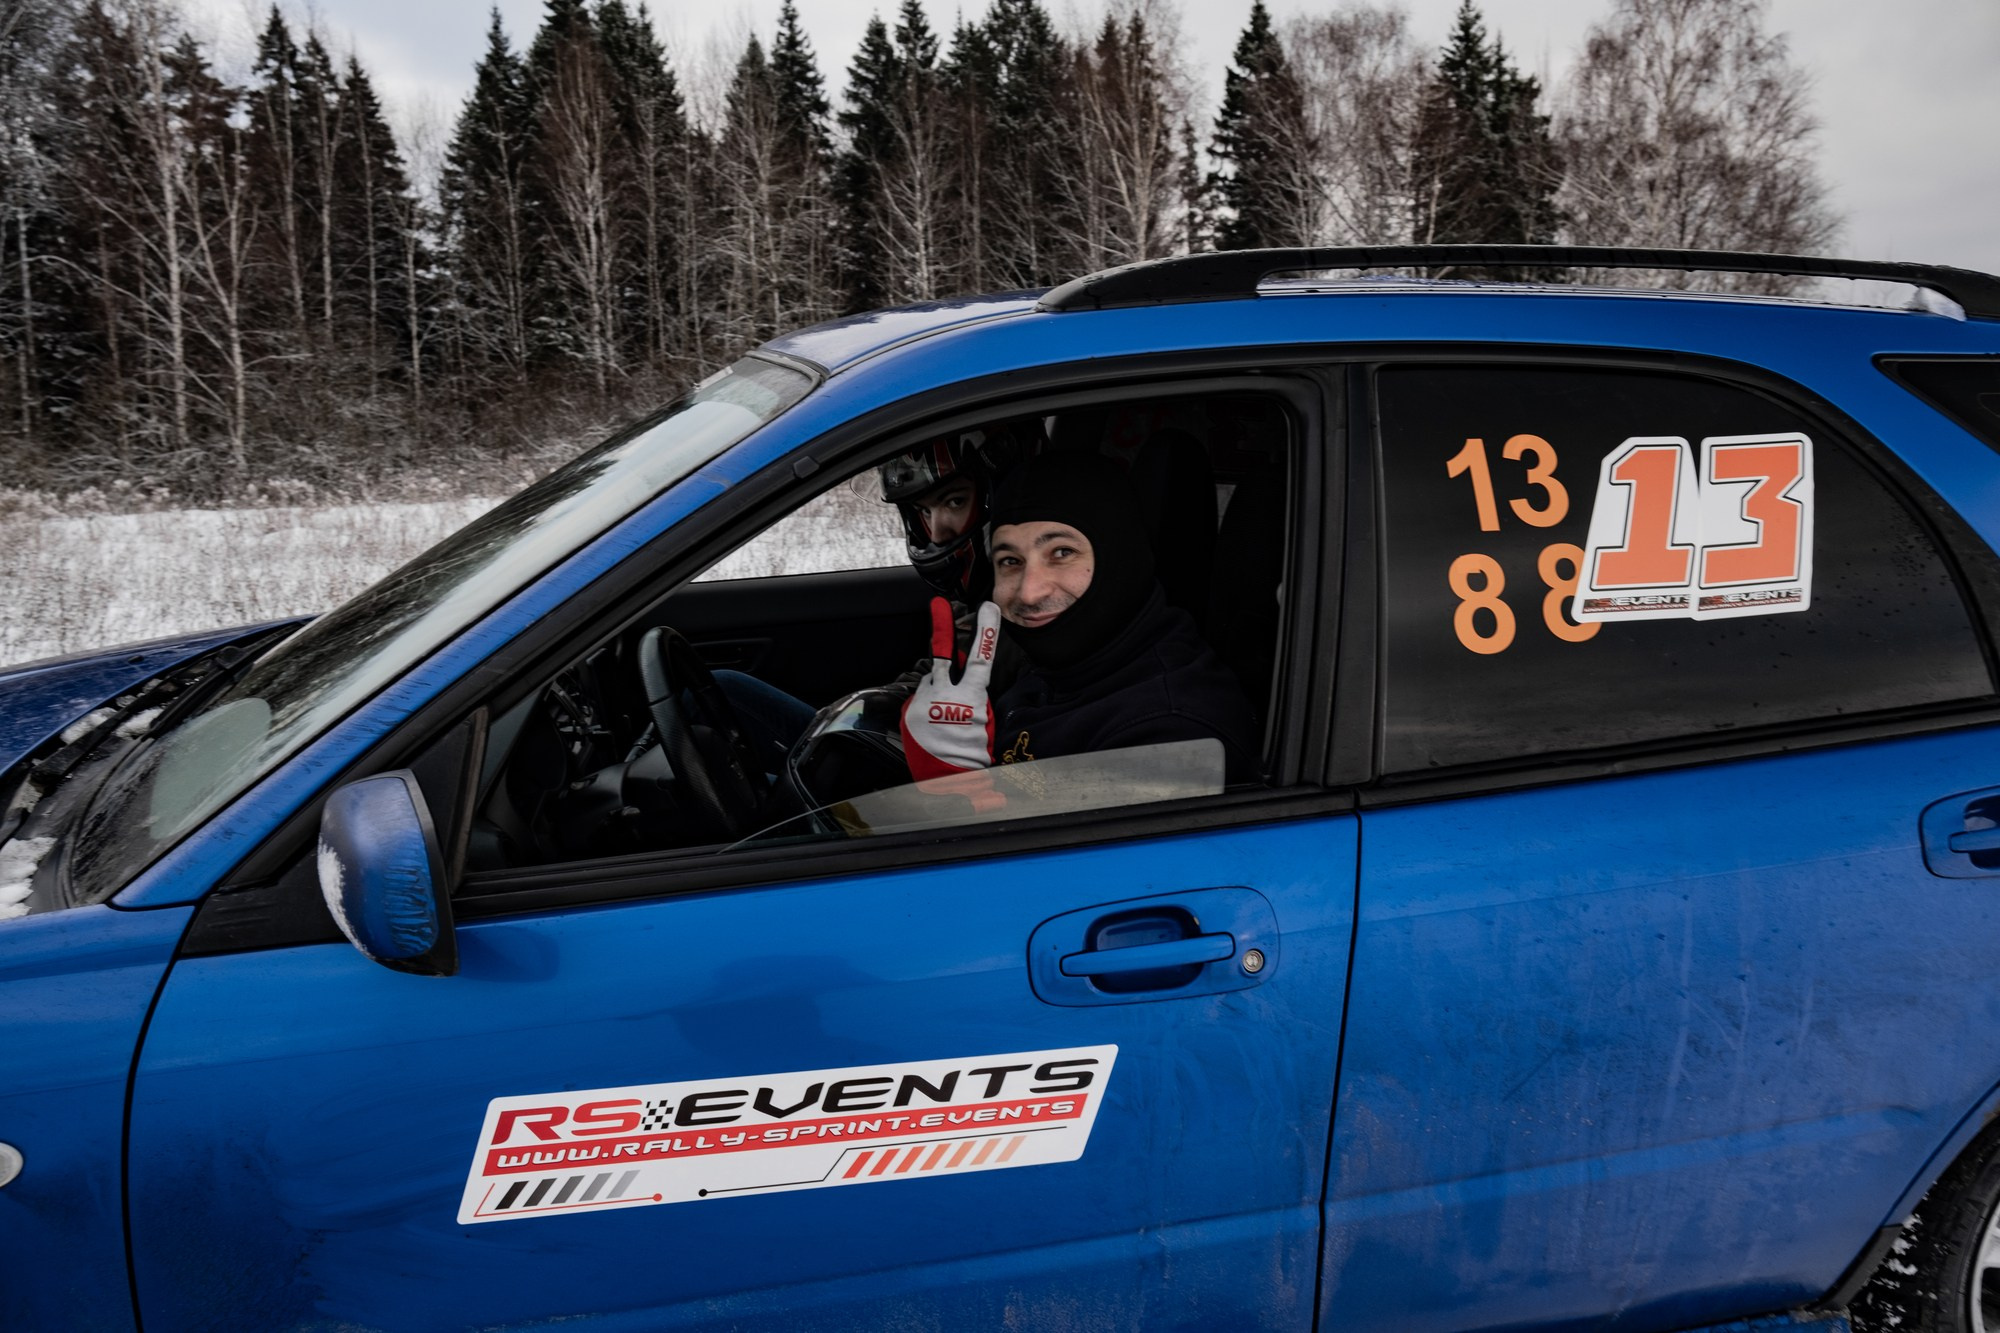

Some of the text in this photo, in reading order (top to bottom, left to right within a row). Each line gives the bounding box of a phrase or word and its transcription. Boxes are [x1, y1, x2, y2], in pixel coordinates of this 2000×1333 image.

[1447, 434, 1569, 532] 13
[1590, 441, 1803, 590] 13
[1727, 588, 1803, 602] EVENTS
[981, 627, 996, 661] OMP
[929, 704, 974, 722] OMP
[491, 1058, 1099, 1145] RS EVENTS
[496, 1100, 1076, 1168] WWW.RALLY-SPRINT.EVENTS
